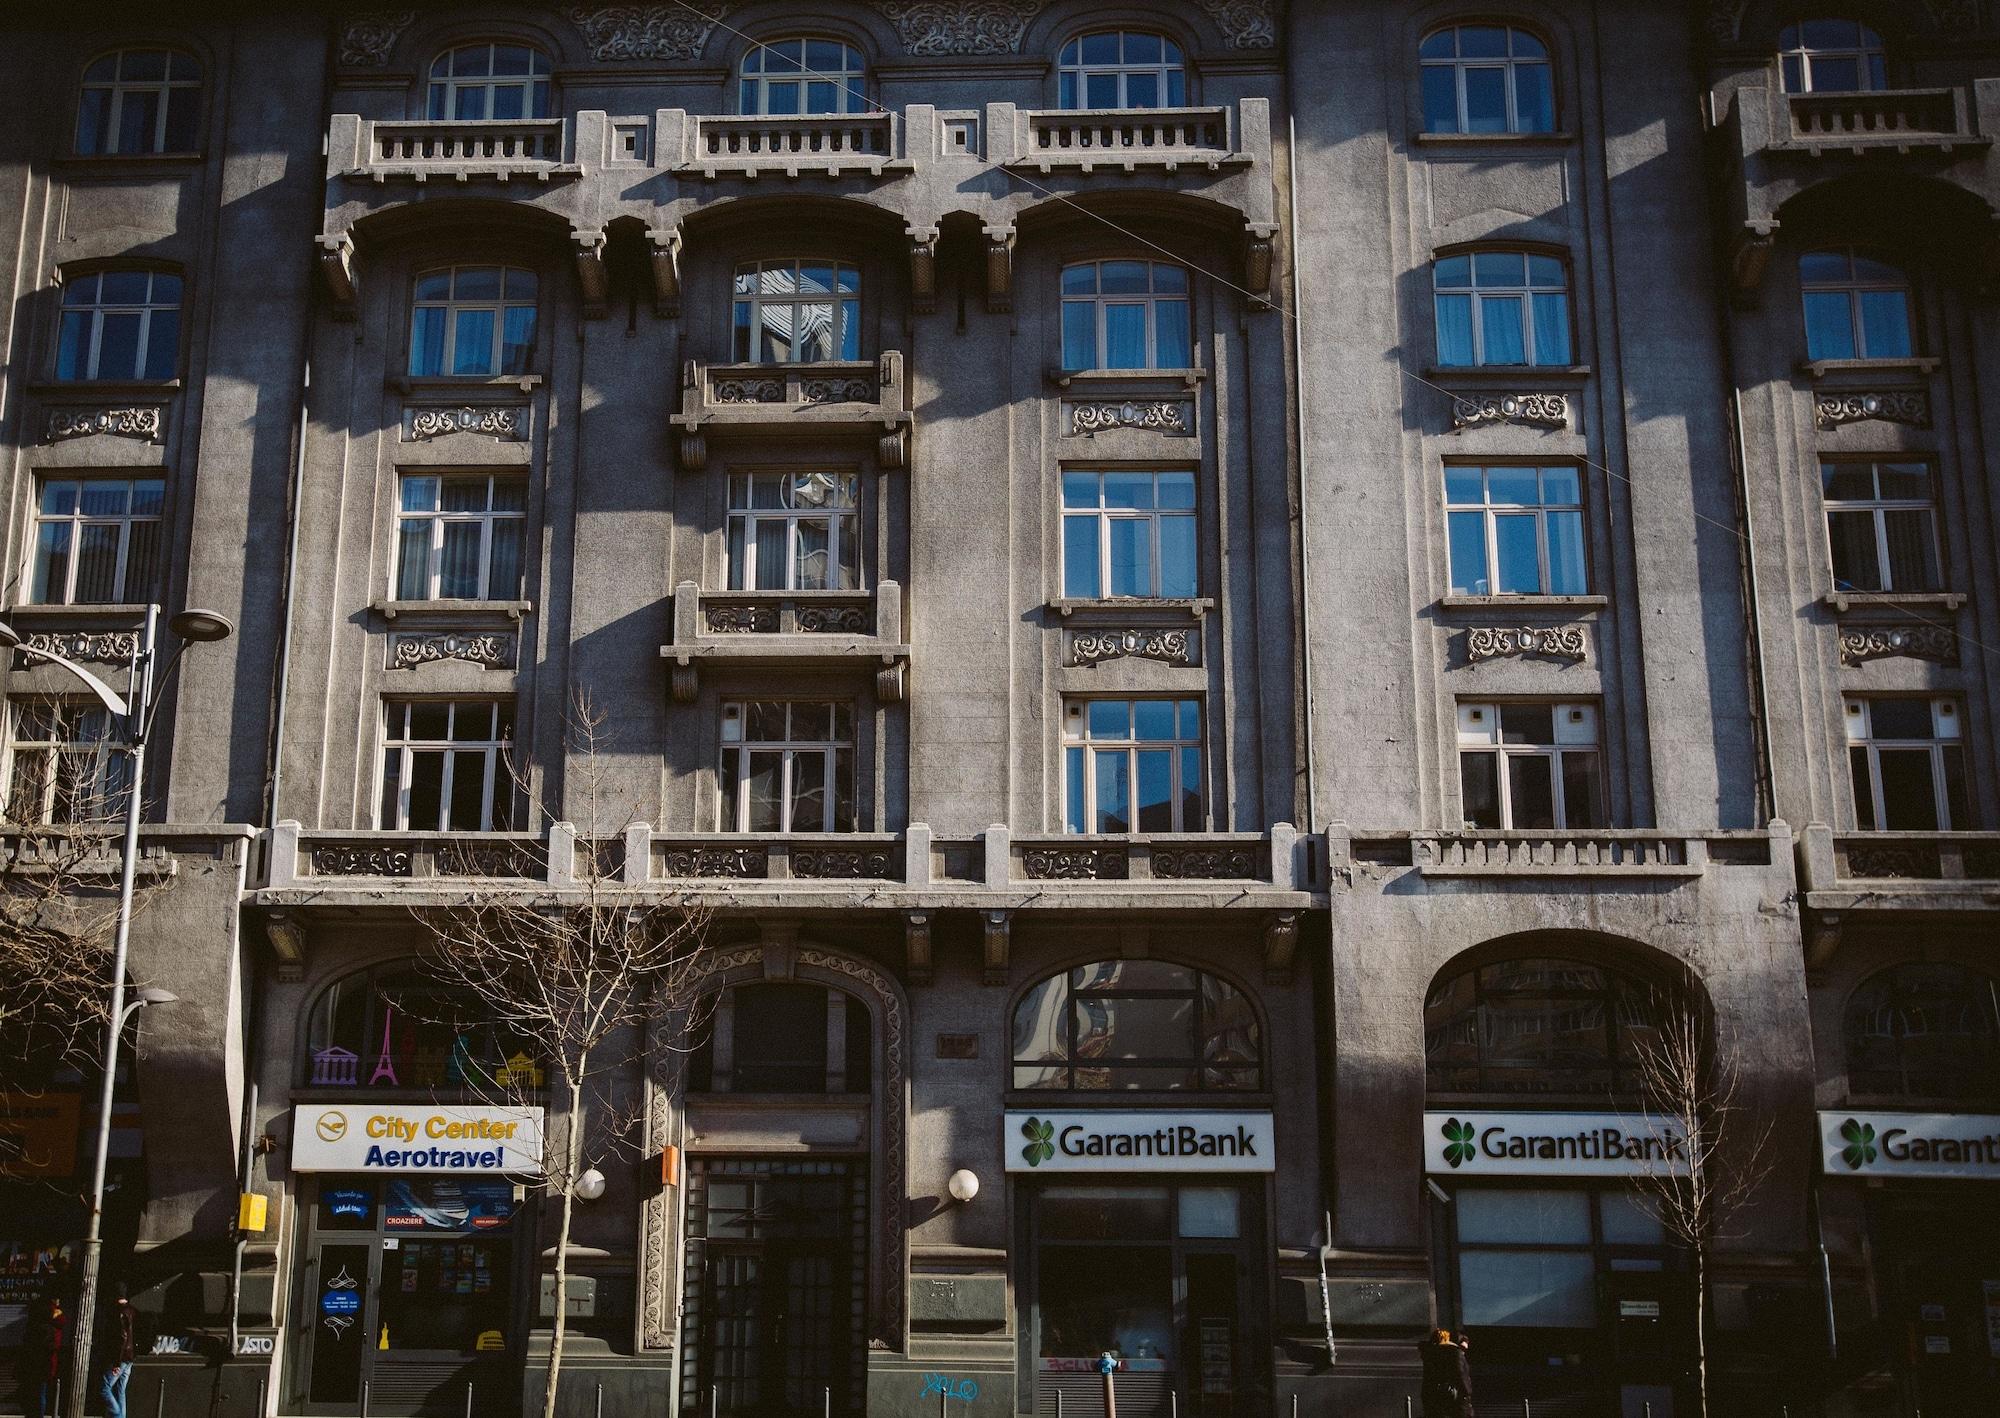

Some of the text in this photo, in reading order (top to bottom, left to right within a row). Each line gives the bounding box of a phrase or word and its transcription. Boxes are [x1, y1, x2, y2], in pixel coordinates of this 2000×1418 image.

[366, 1115, 518, 1142] City Center
[1059, 1126, 1257, 1156] GarantiBank
[365, 1145, 504, 1168] Aerotravel
[1481, 1127, 1685, 1160] GarantiBank
[386, 1217, 423, 1226] CROAZIERE
